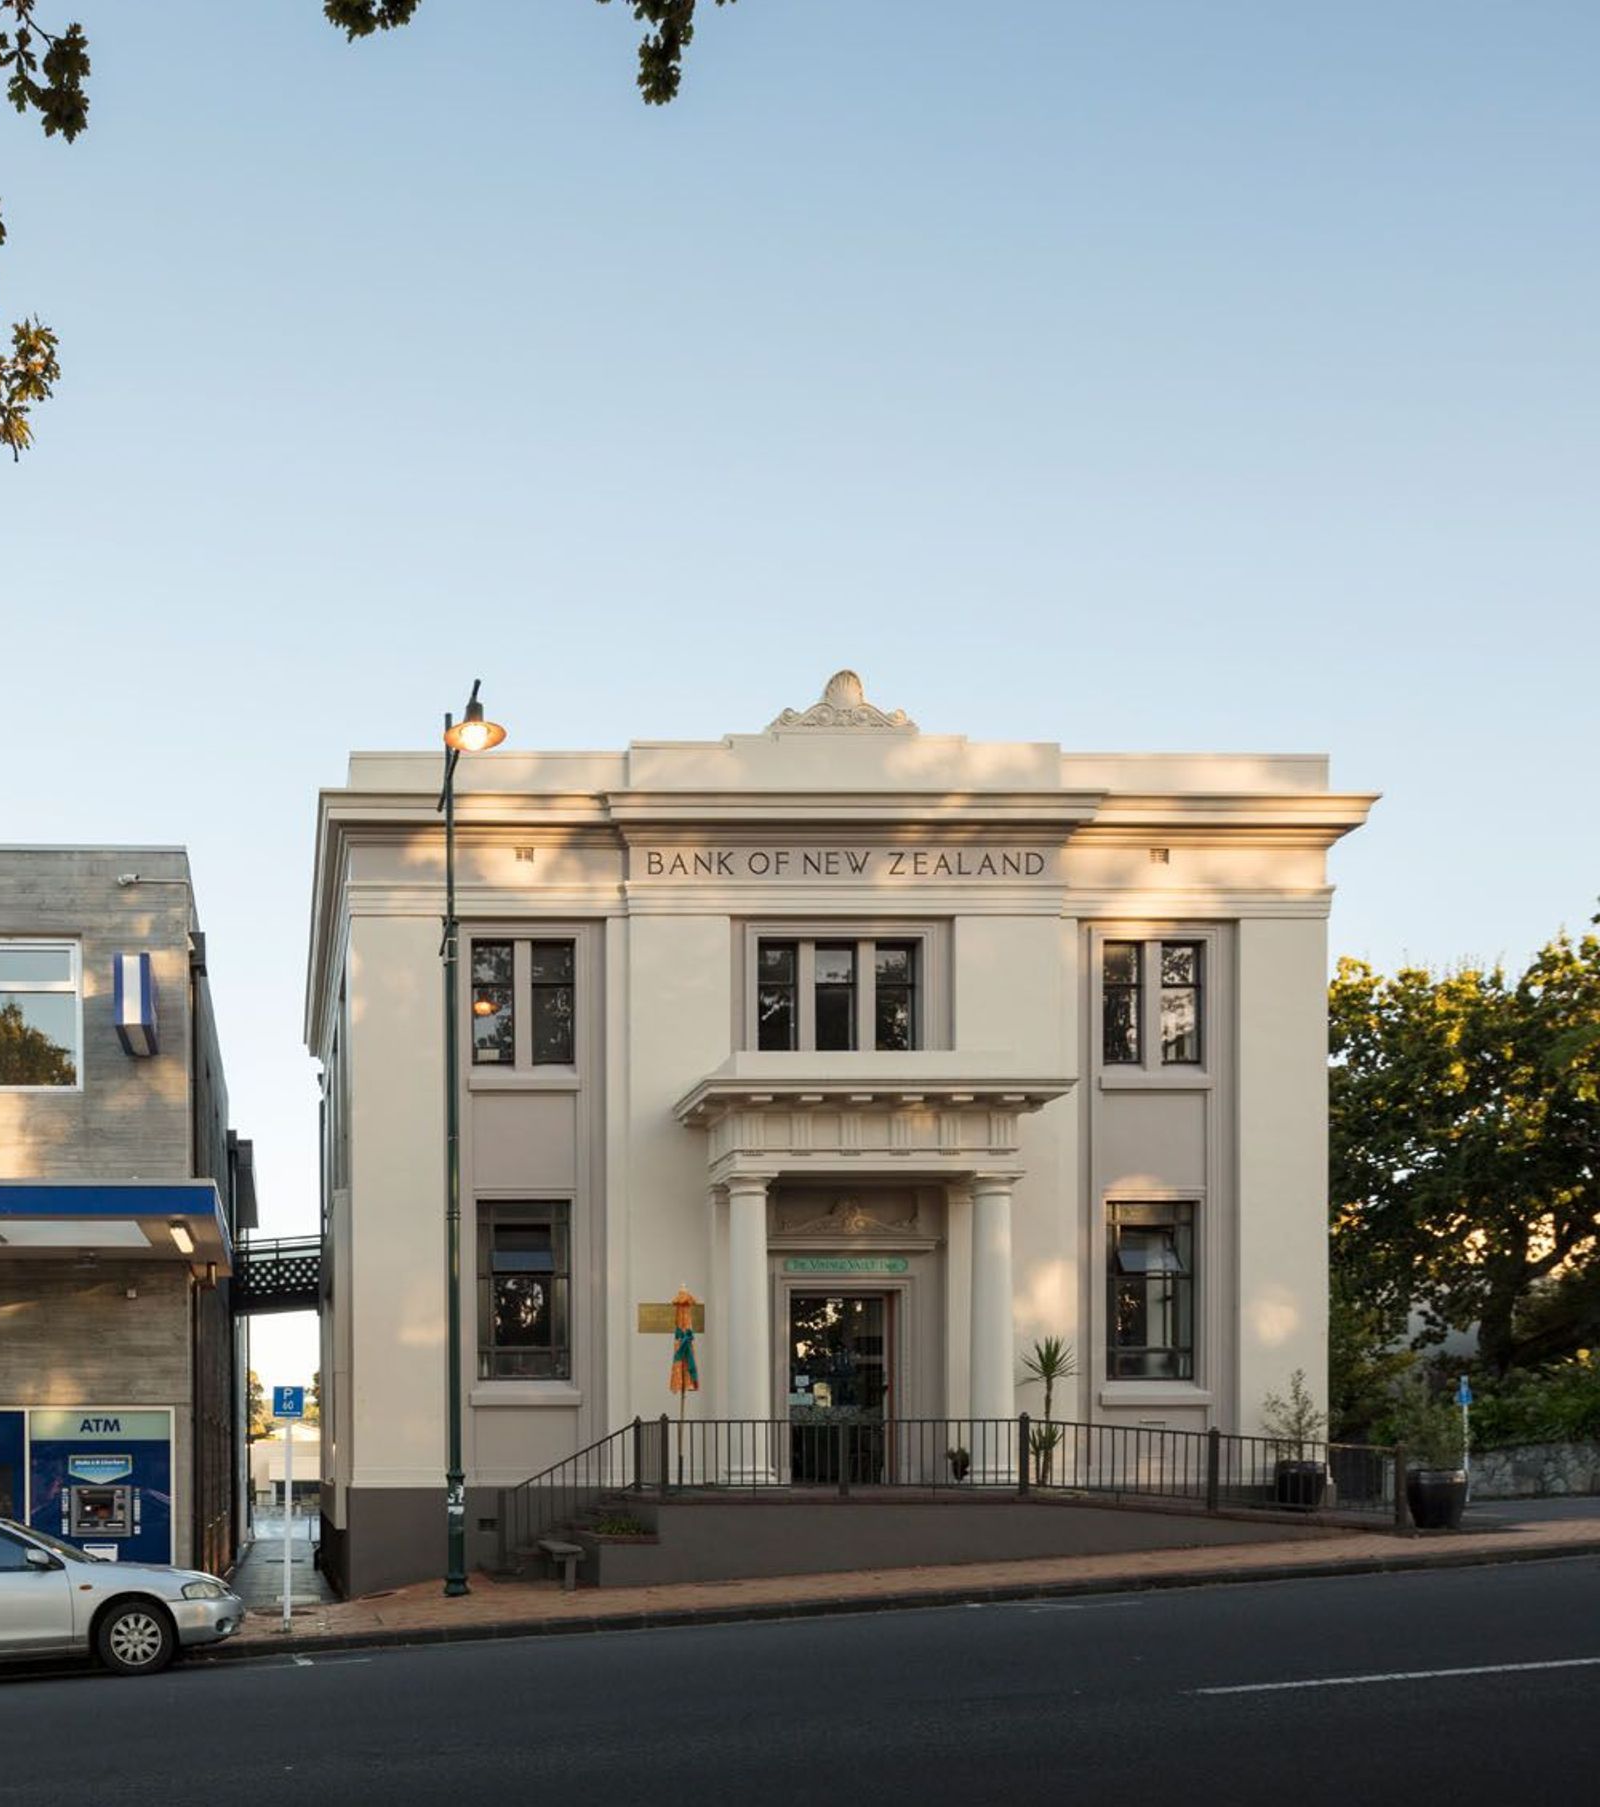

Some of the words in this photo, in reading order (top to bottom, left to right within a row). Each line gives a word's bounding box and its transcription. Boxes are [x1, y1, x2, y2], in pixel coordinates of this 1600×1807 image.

[647, 852, 735, 875] BANK
[748, 851, 790, 875] OF
[803, 852, 871, 875] NEW
[888, 852, 1045, 875] ZEALAND
[283, 1387, 293, 1400] P
[80, 1419, 121, 1433] ATM
